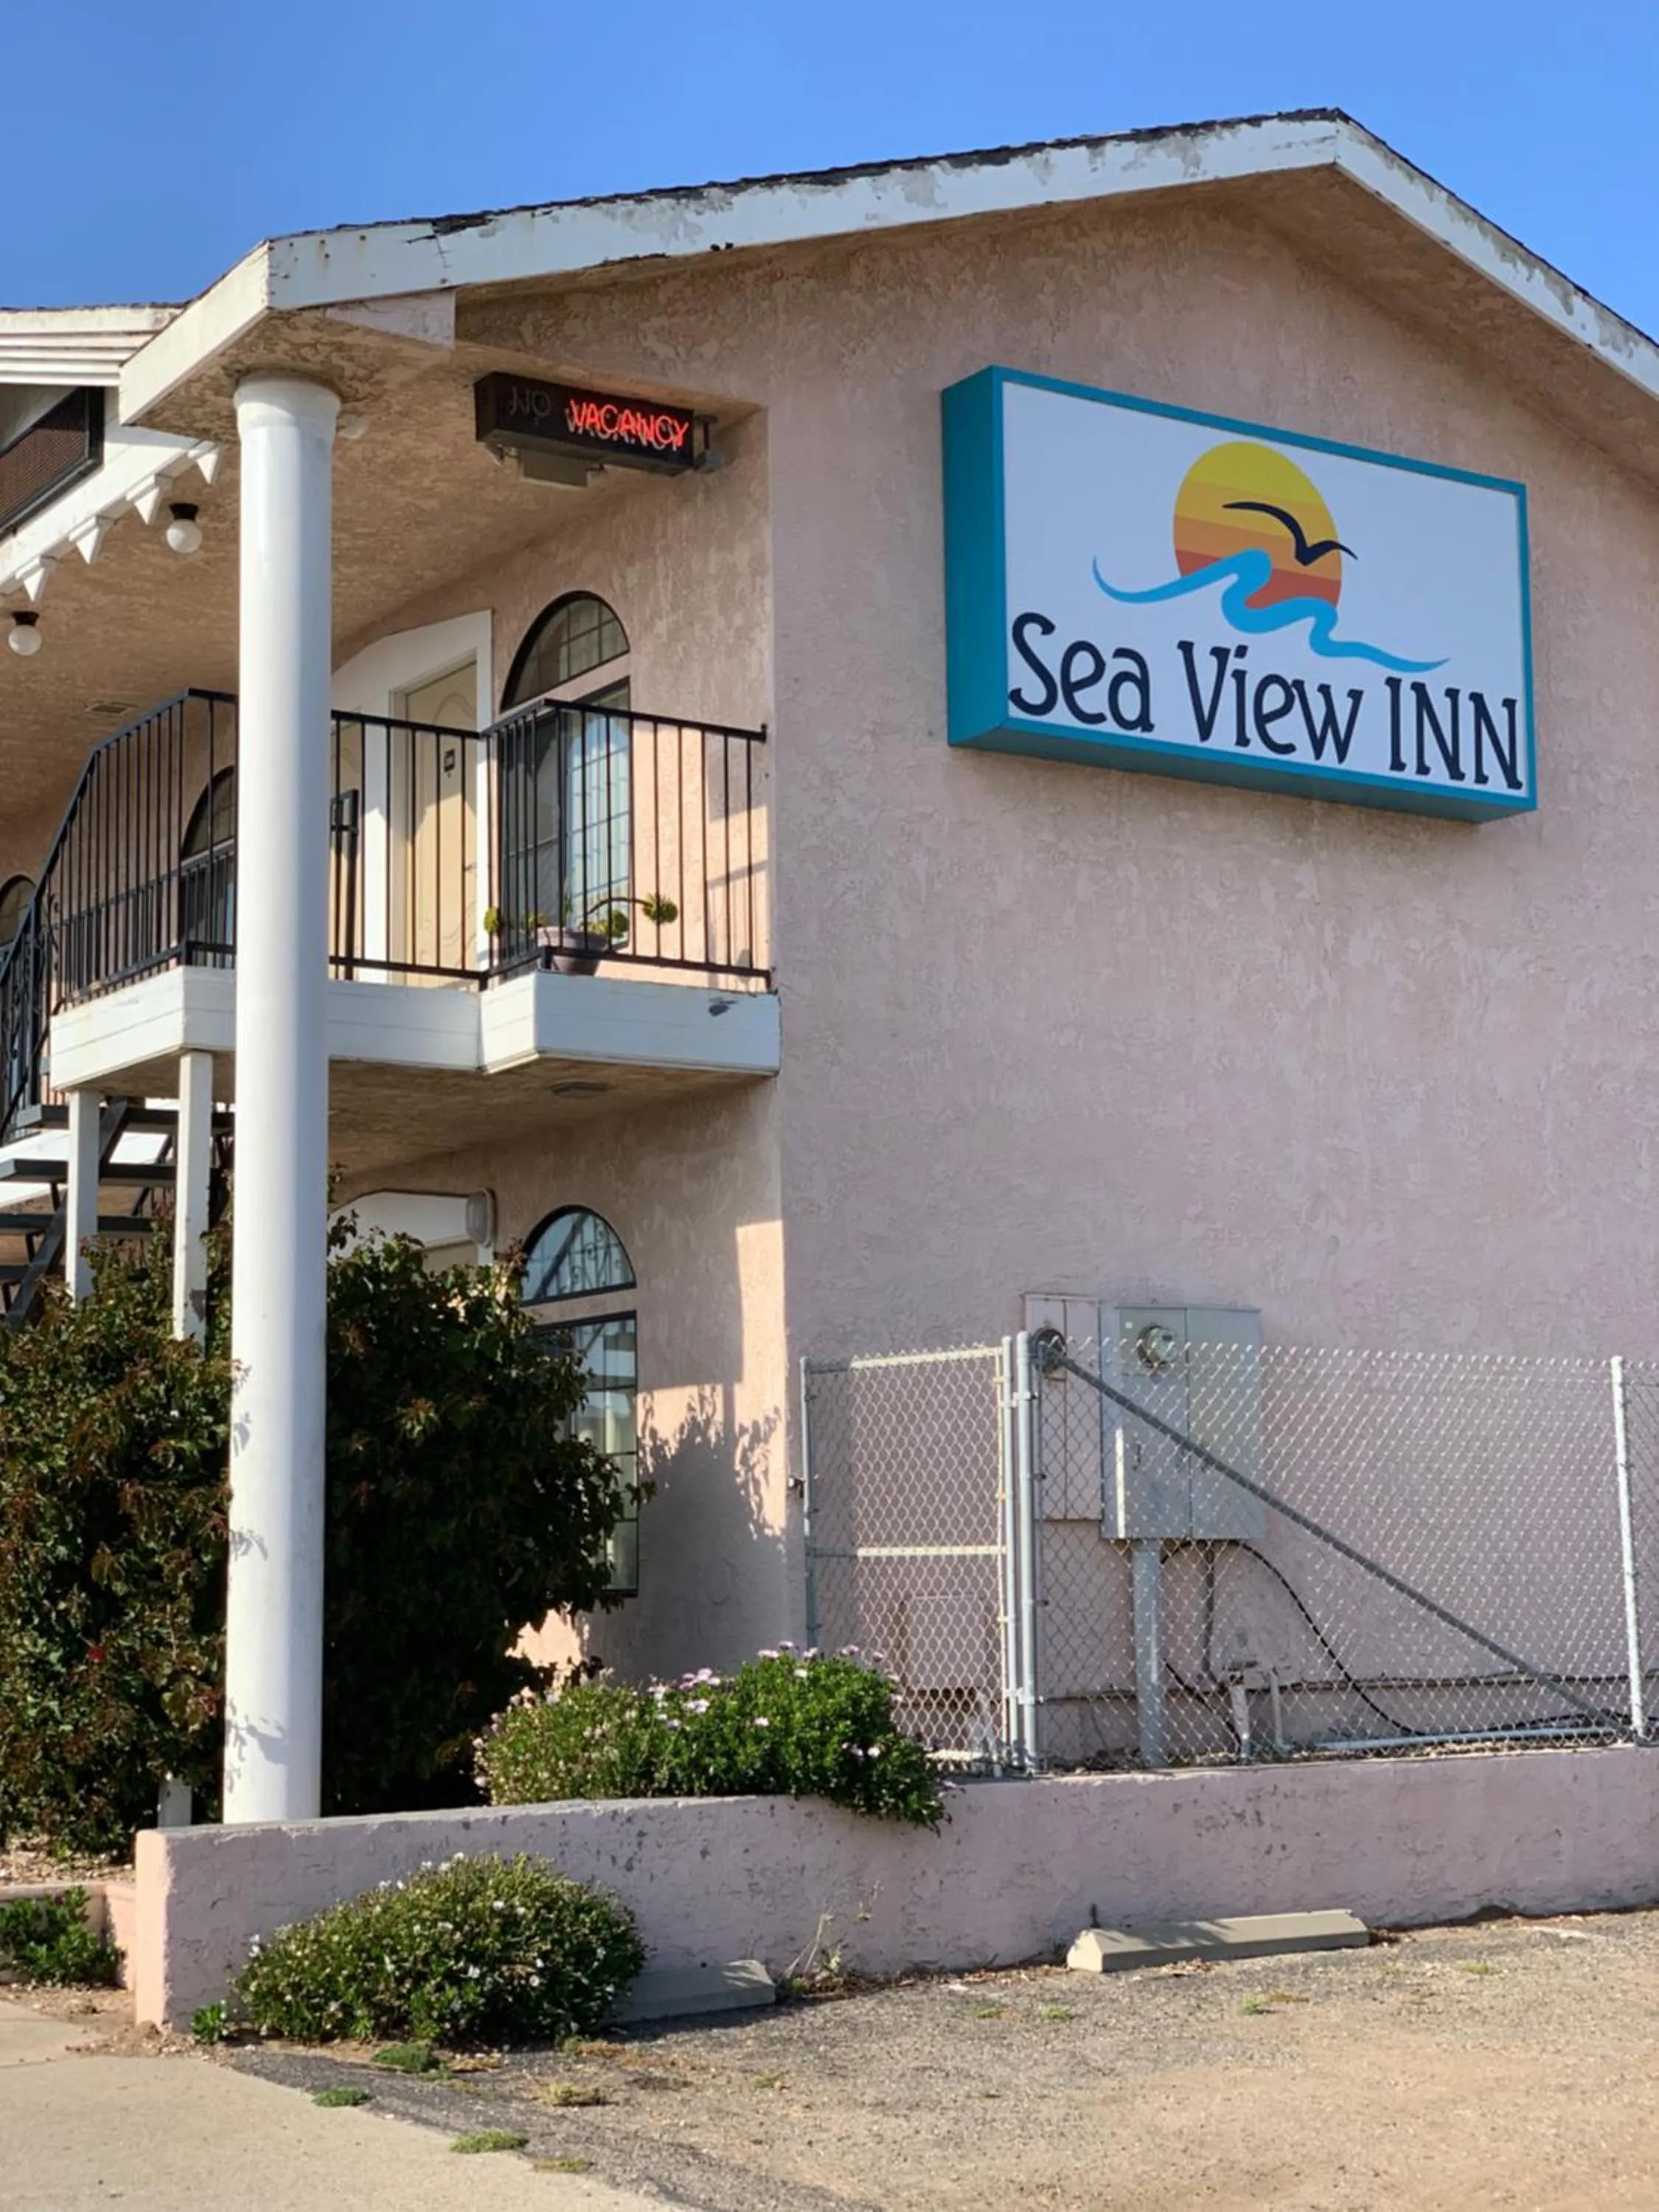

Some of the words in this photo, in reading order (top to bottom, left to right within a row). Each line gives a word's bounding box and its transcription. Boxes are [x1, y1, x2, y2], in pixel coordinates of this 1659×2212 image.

[509, 387, 551, 418] NO
[569, 400, 688, 447] VACANCY
[1009, 611, 1155, 733] Sea
[1178, 641, 1364, 764] View
[1385, 676, 1523, 790] INN
